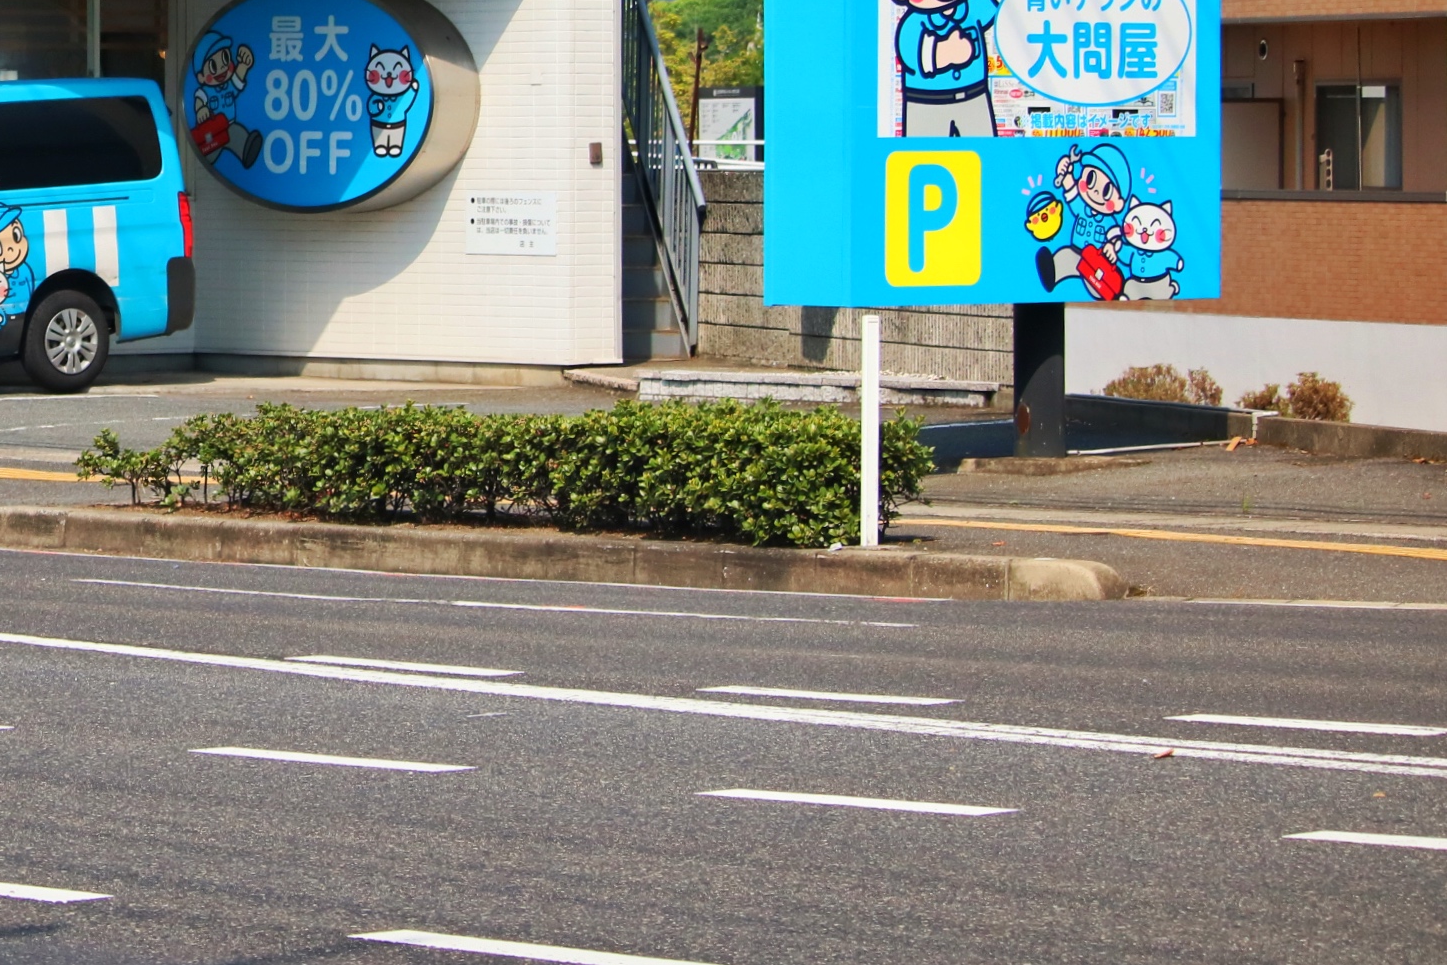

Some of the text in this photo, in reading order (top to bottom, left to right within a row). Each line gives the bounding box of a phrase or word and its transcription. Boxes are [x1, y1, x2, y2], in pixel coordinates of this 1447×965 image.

[268, 15, 349, 63] 最大
[1026, 19, 1158, 80] 大問屋
[264, 69, 363, 122] 80%
[263, 130, 353, 176] OFF
[908, 164, 958, 273] P
